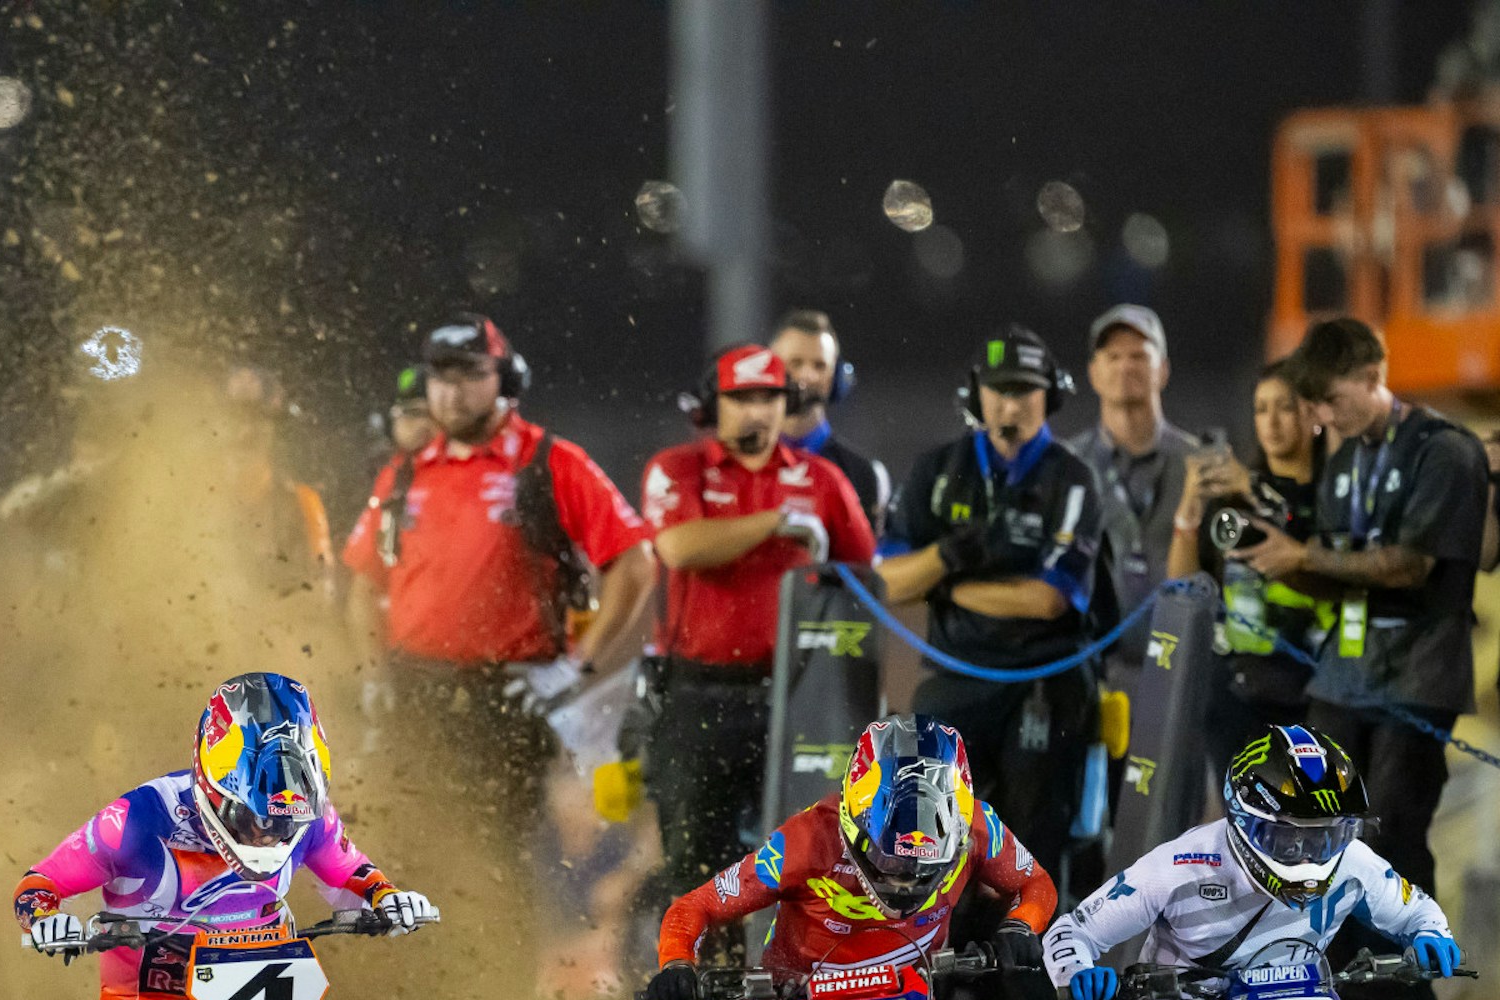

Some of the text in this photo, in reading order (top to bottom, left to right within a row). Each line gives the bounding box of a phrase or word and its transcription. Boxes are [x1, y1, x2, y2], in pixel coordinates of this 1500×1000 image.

[267, 804, 312, 816] Red Bull
[894, 845, 939, 858] Red Bull
[1203, 887, 1225, 897] 100%
[208, 932, 284, 946] RENTHAL
[1244, 965, 1304, 984] PROTAPER
[814, 974, 892, 993] RENTHAL
